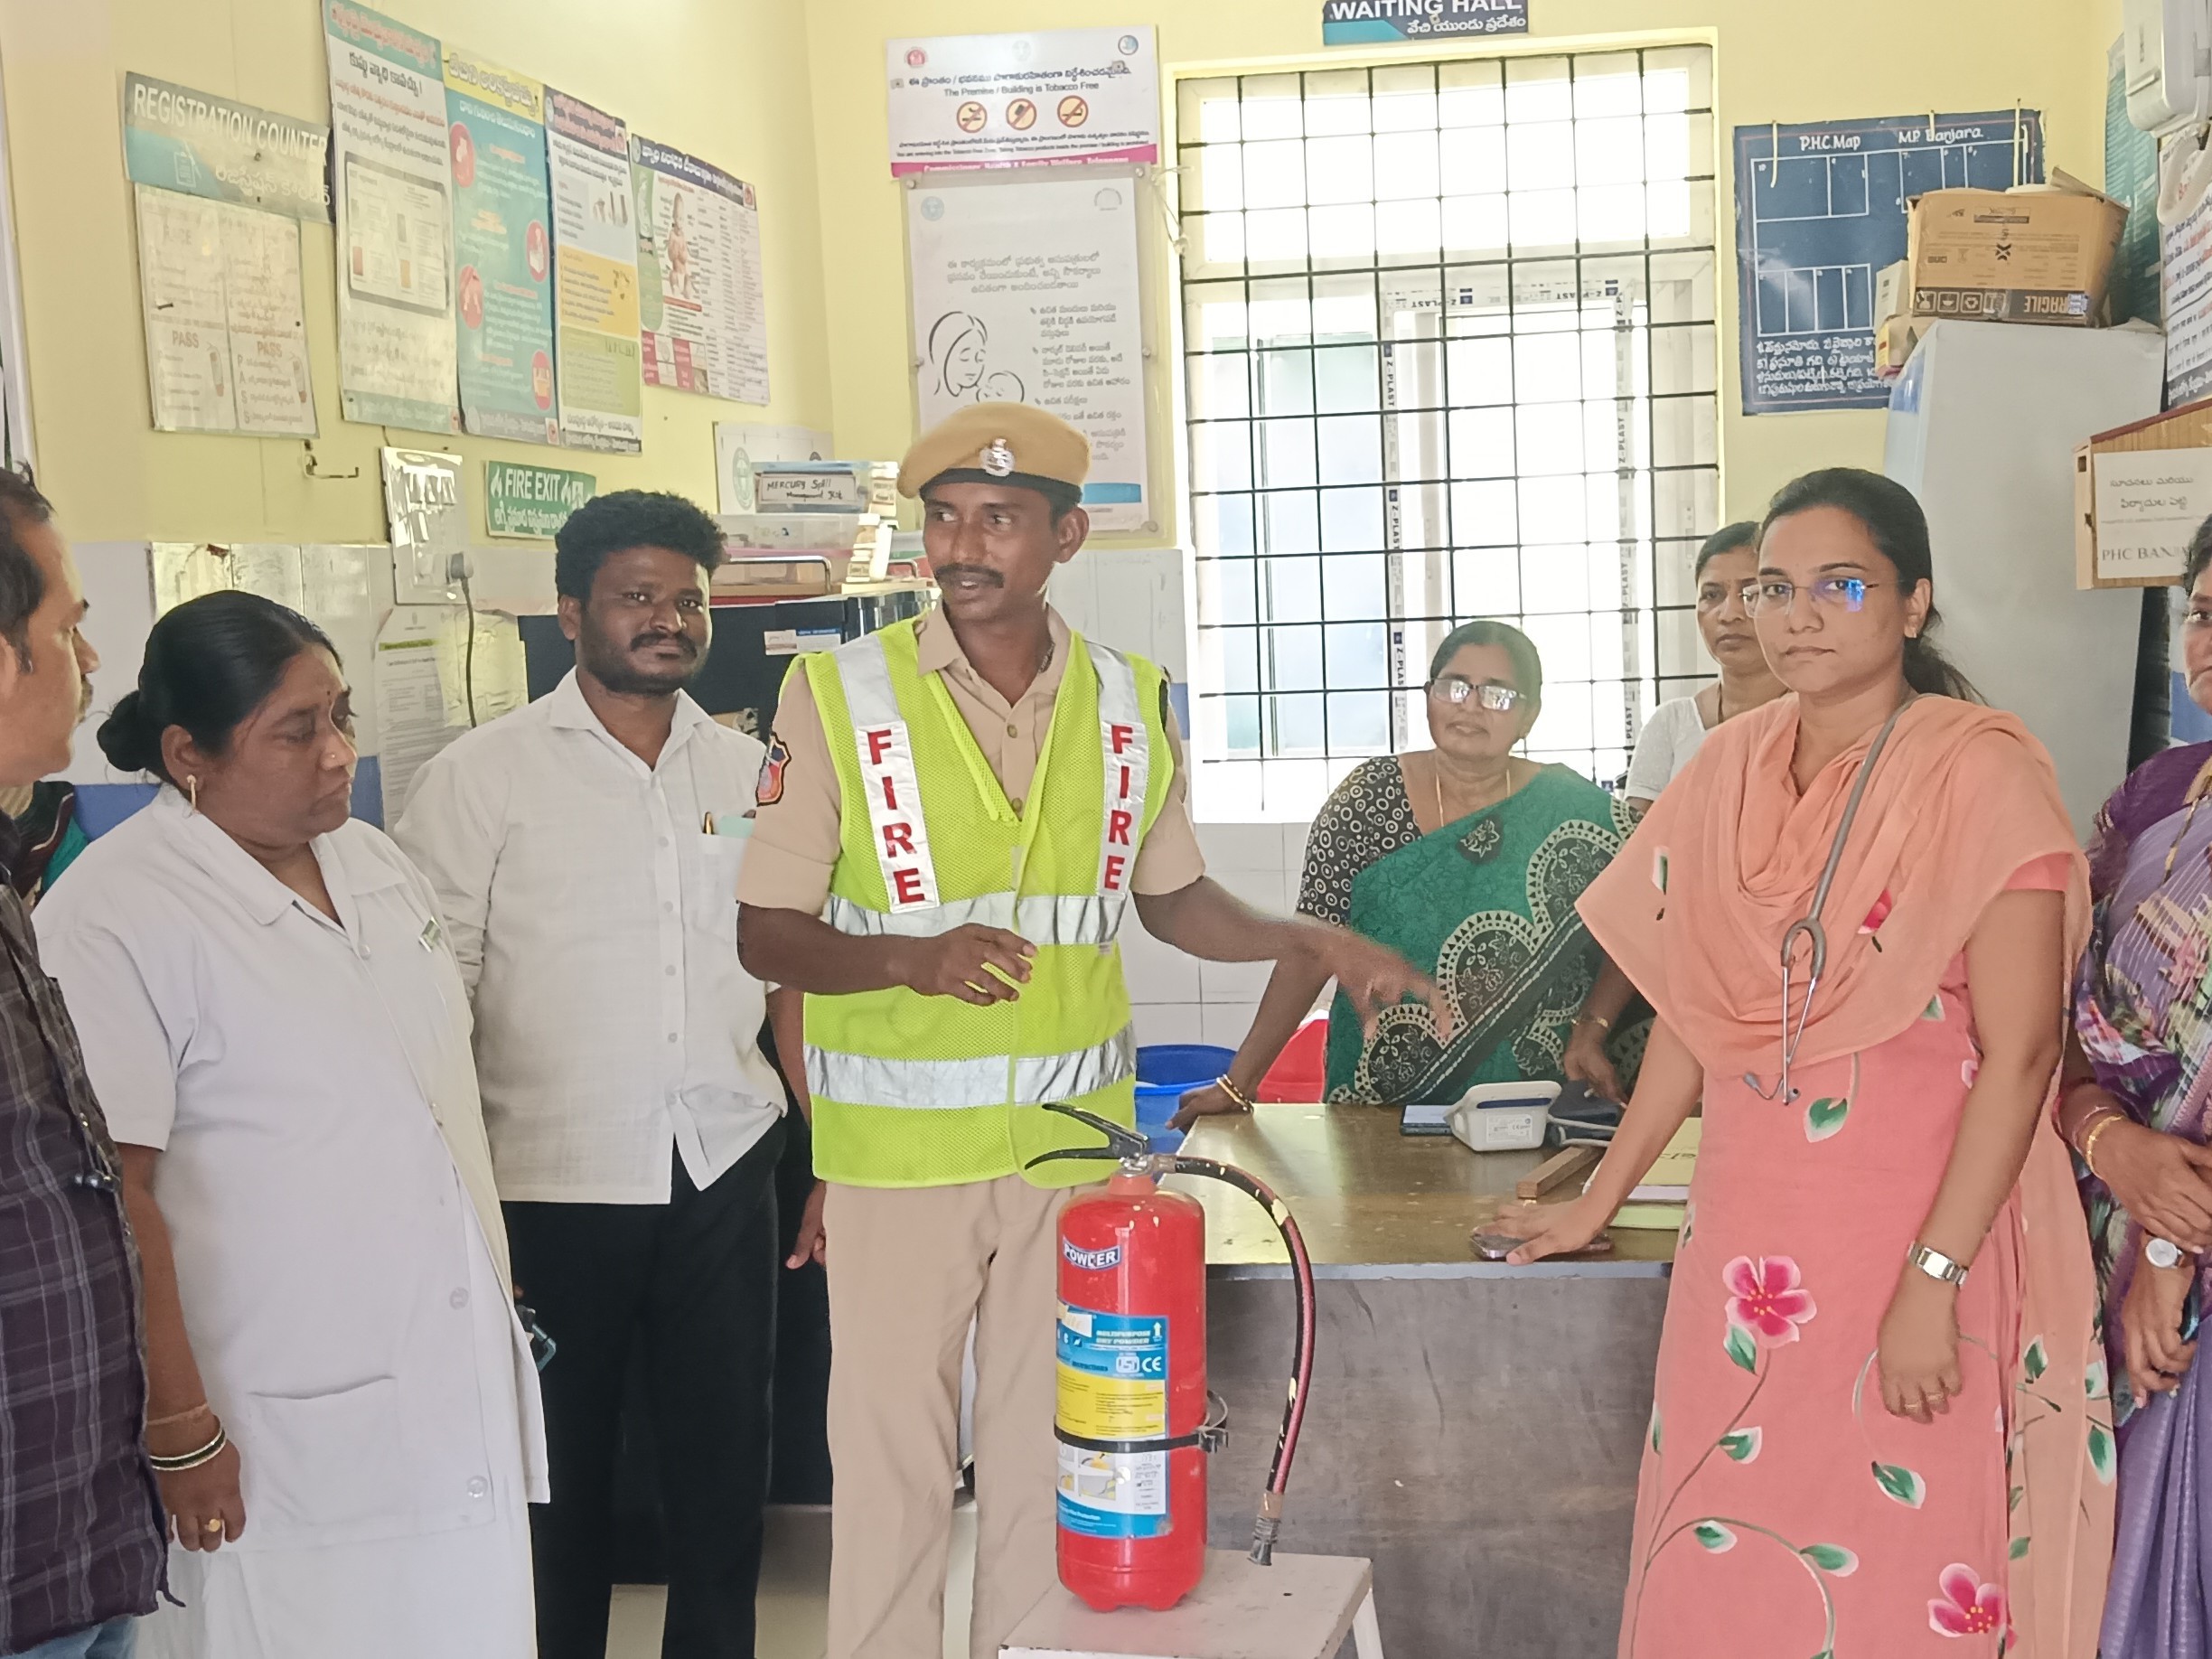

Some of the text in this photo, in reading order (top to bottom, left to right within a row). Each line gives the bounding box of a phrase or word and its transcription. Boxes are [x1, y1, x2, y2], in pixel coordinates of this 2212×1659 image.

[1331, 0, 1522, 20] WAITING HALL
[1407, 20, 1431, 33] వేచి
[1485, 14, 1526, 33] ప్రదేశం
[922, 76, 951, 88] ప్రాంతం
[944, 88, 960, 98] The
[961, 87, 994, 97] Premise
[1002, 86, 1034, 96] Building
[1036, 85, 1043, 93] is
[1045, 83, 1079, 92] Tobacco
[1081, 81, 1099, 91] Free
[135, 83, 253, 145] REGISTRATION
[257, 120, 328, 165] COUNTER
[1557, 291, 1602, 300] Z-PAST
[2023, 295, 2067, 314] RAGILE
[172, 330, 199, 349] PASS
[257, 341, 283, 358] PASS
[1387, 361, 1395, 407] Z-PLAST
[1617, 417, 1626, 464] Z-PLAST
[506, 467, 560, 501] FIRE EXIT
[767, 479, 806, 491] MERCURY
[2102, 548, 2132, 561] PHC
[1396, 648, 1405, 686] Z-PLAS
[867, 728, 925, 904] FIRE
[1104, 725, 1133, 890] FIRE
[1141, 1356, 1162, 1373] CE
